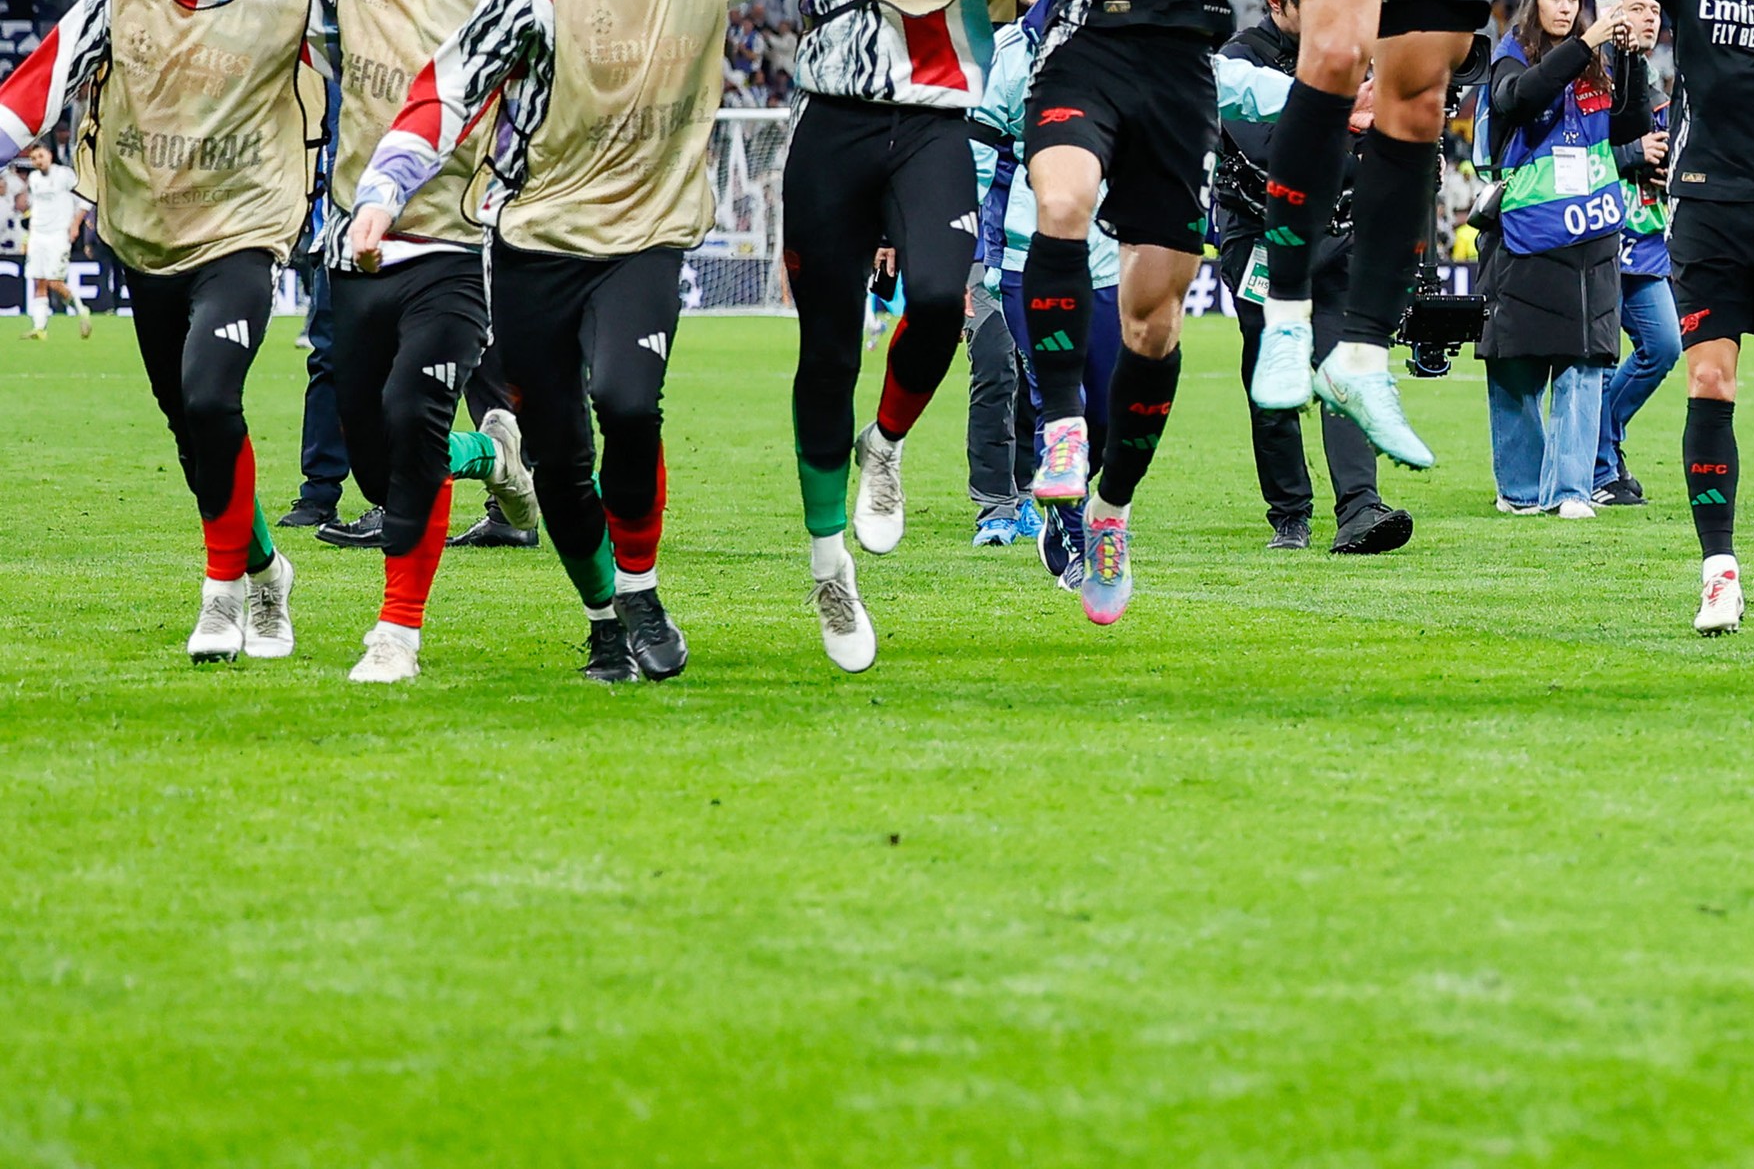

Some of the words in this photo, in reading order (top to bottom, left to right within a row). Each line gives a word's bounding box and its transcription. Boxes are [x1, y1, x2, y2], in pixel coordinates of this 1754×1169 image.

[1711, 22, 1737, 44] FLY
[1563, 192, 1621, 236] 058
[1031, 297, 1076, 311] AFC
[1129, 400, 1171, 415] AFC
[1690, 461, 1729, 475] AFC
